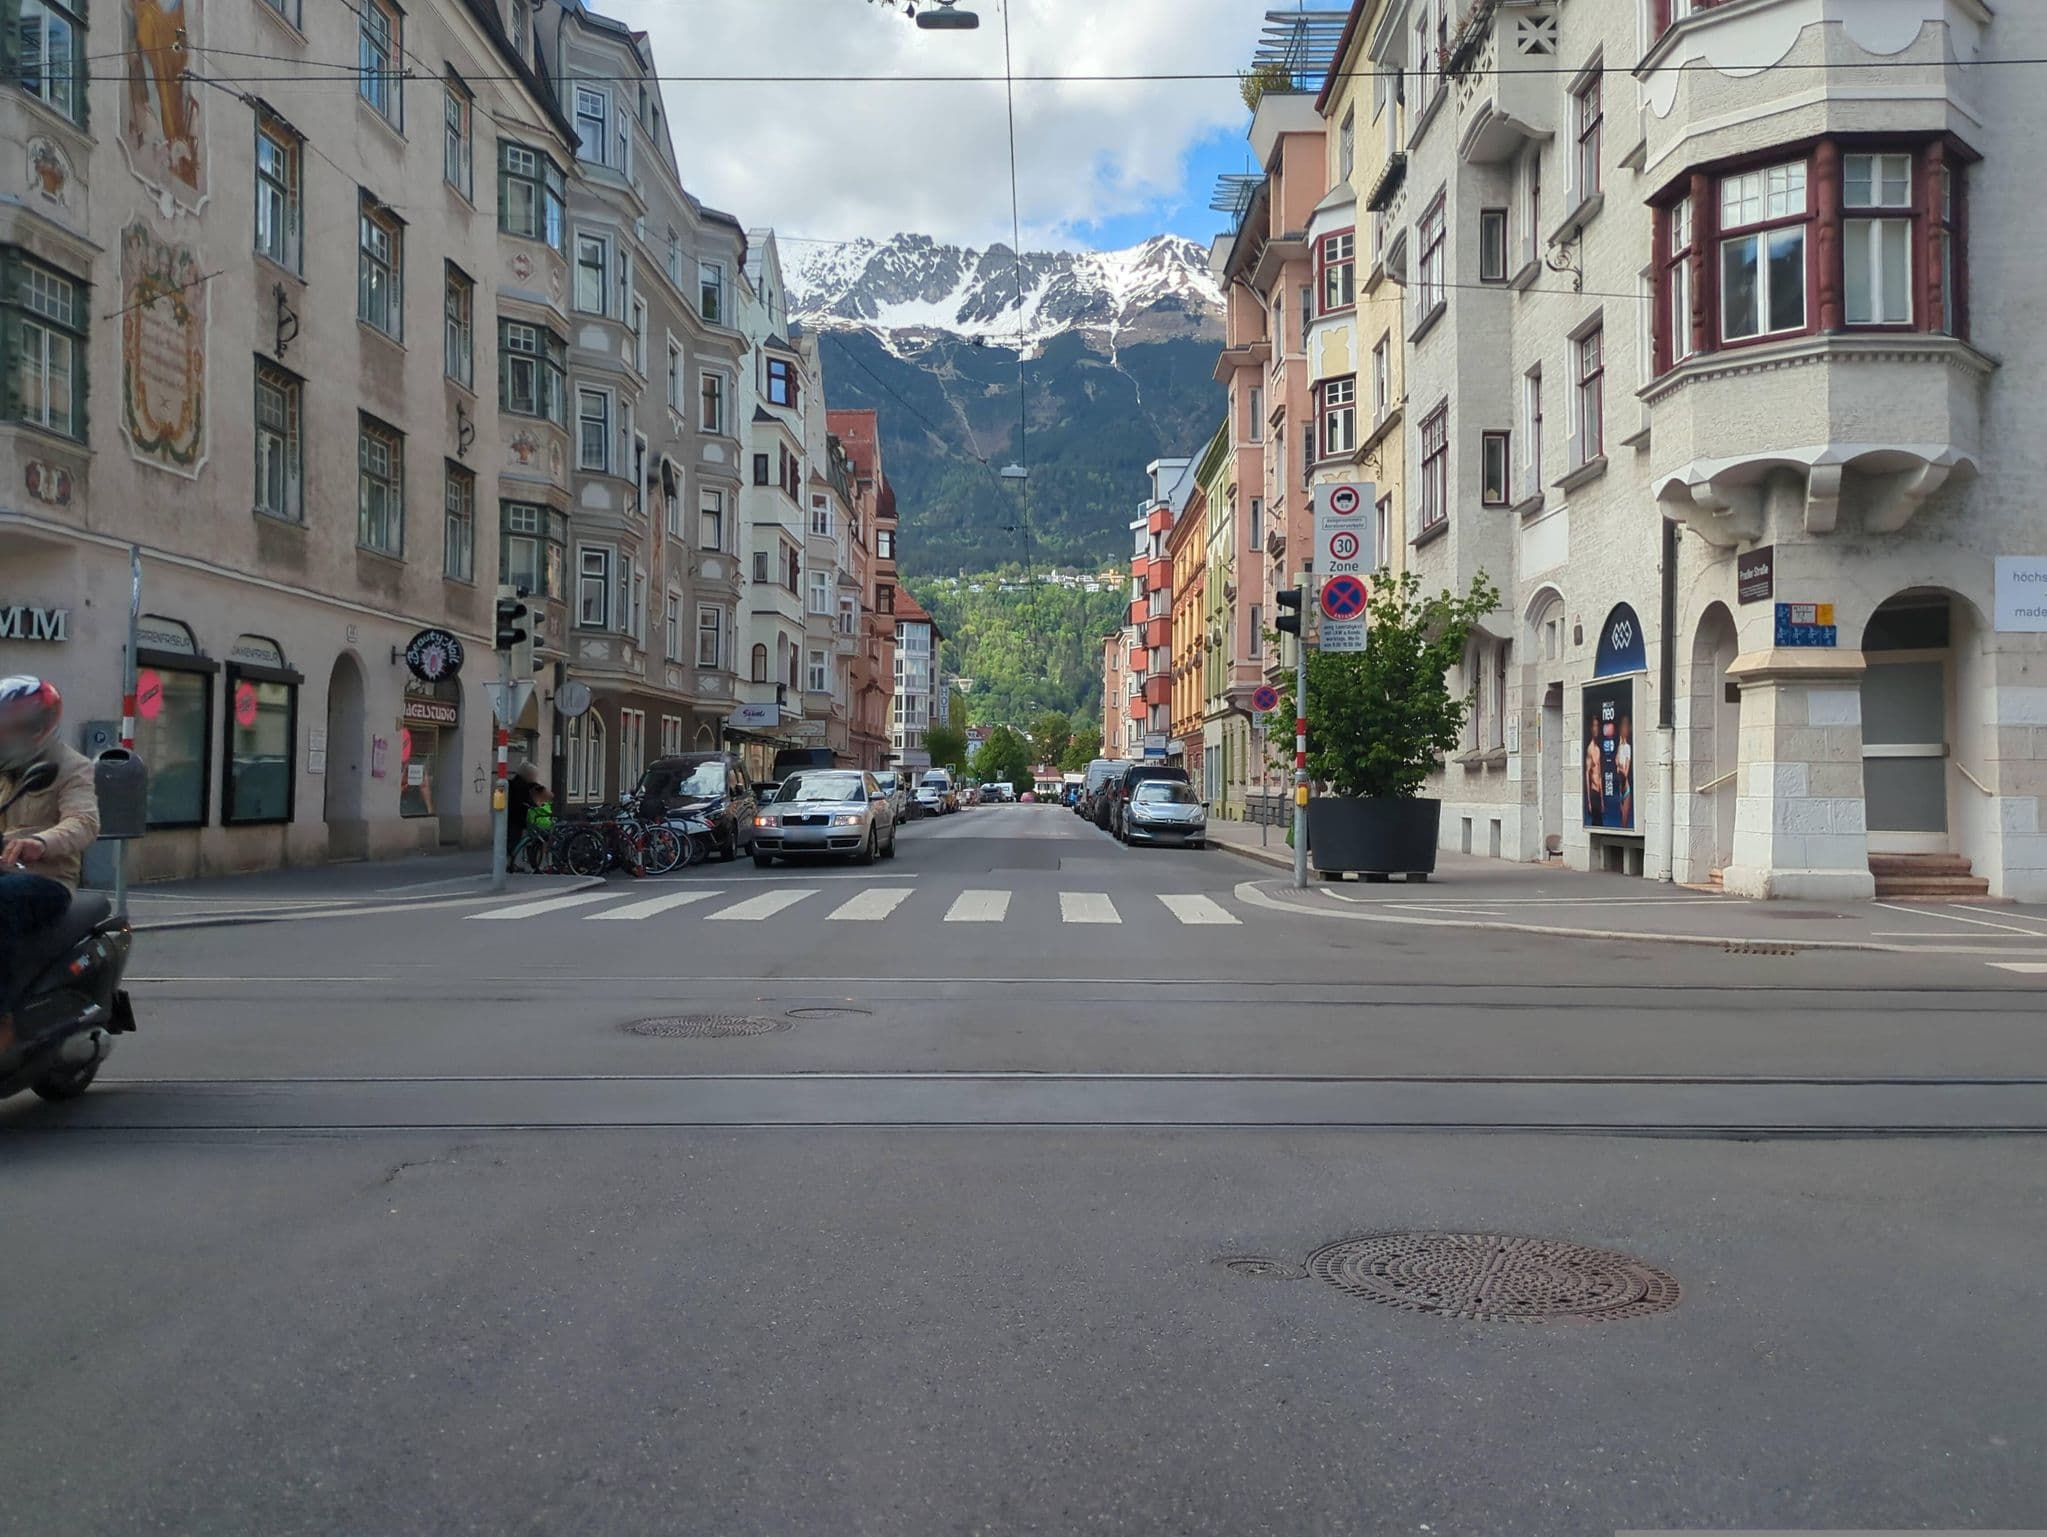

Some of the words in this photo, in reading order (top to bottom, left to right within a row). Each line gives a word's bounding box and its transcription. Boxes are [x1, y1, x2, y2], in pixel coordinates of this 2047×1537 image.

[1336, 539, 1352, 553] 30
[1329, 561, 1359, 572] Zone
[2014, 606, 2047, 617] made
